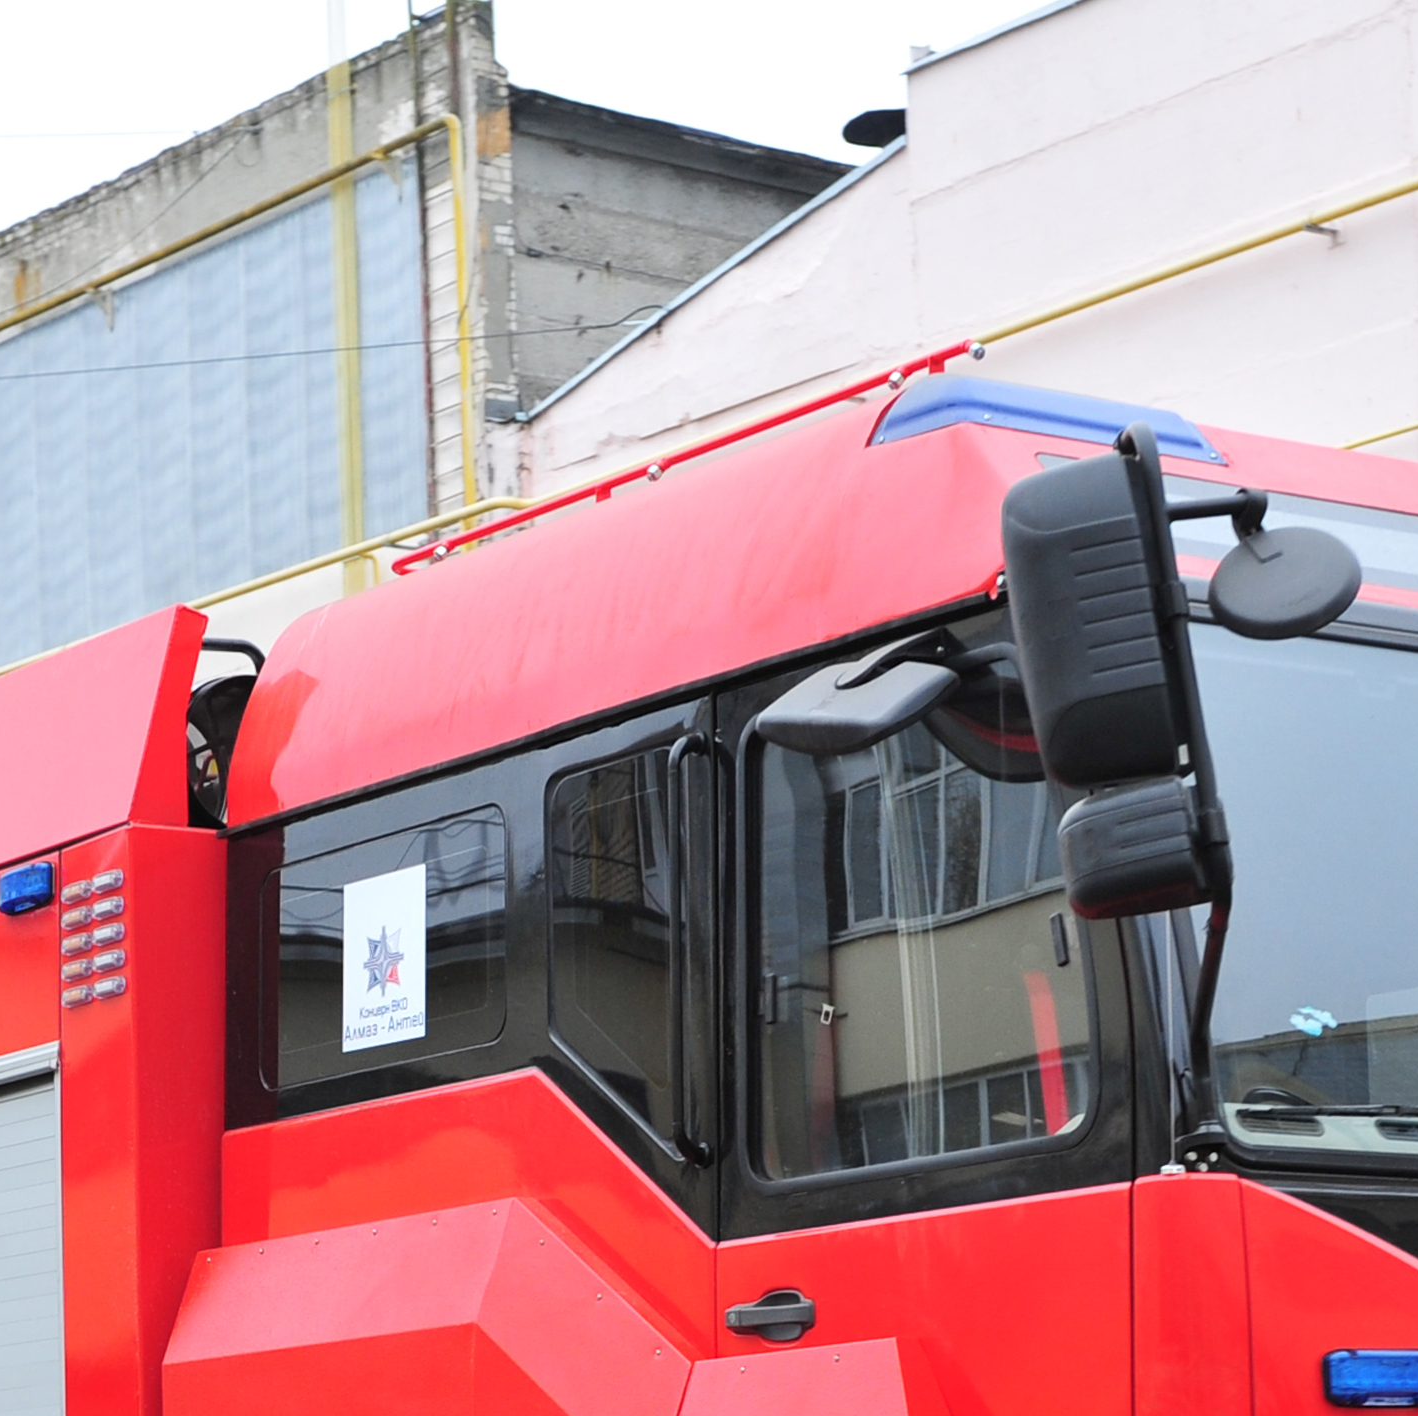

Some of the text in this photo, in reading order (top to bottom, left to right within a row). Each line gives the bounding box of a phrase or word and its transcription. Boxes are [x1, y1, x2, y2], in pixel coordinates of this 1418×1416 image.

[359, 997, 408, 1019] Концерн ВКО
[344, 1023, 378, 1042] Алмаз
